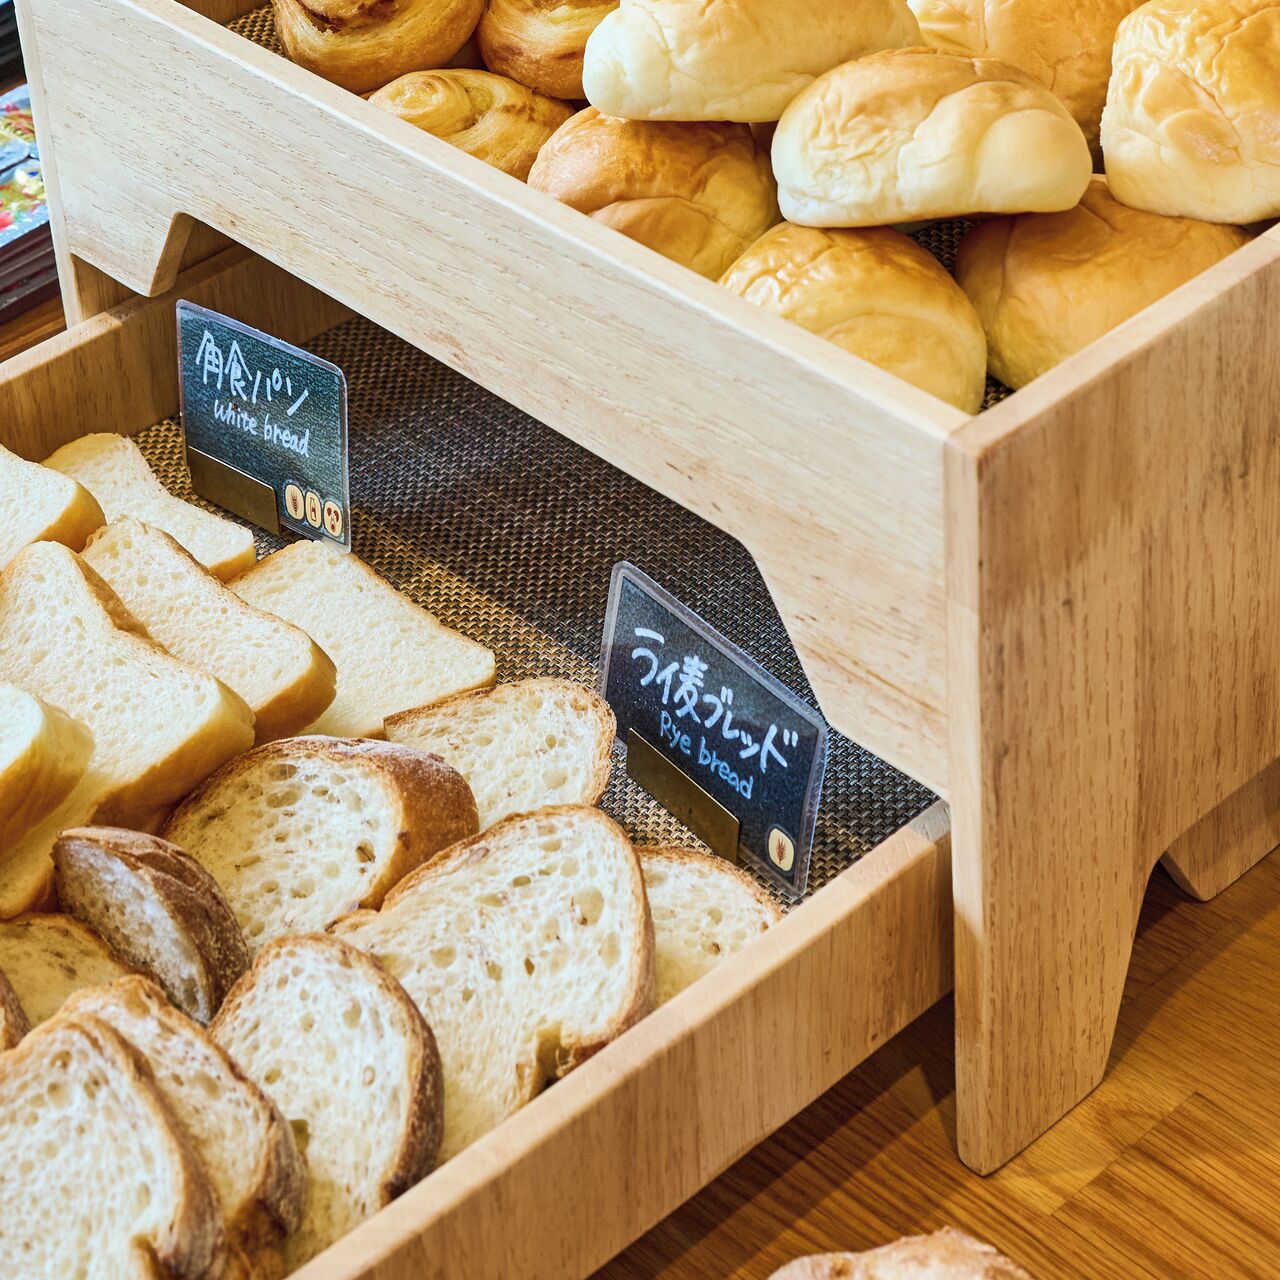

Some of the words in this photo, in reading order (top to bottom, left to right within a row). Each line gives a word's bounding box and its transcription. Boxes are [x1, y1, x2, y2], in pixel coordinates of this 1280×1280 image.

[195, 329, 309, 417] 角食パン
[263, 413, 310, 458] bread
[631, 626, 799, 774] ライ麦ブレッド
[659, 709, 692, 757] Rye
[697, 739, 755, 801] bread
